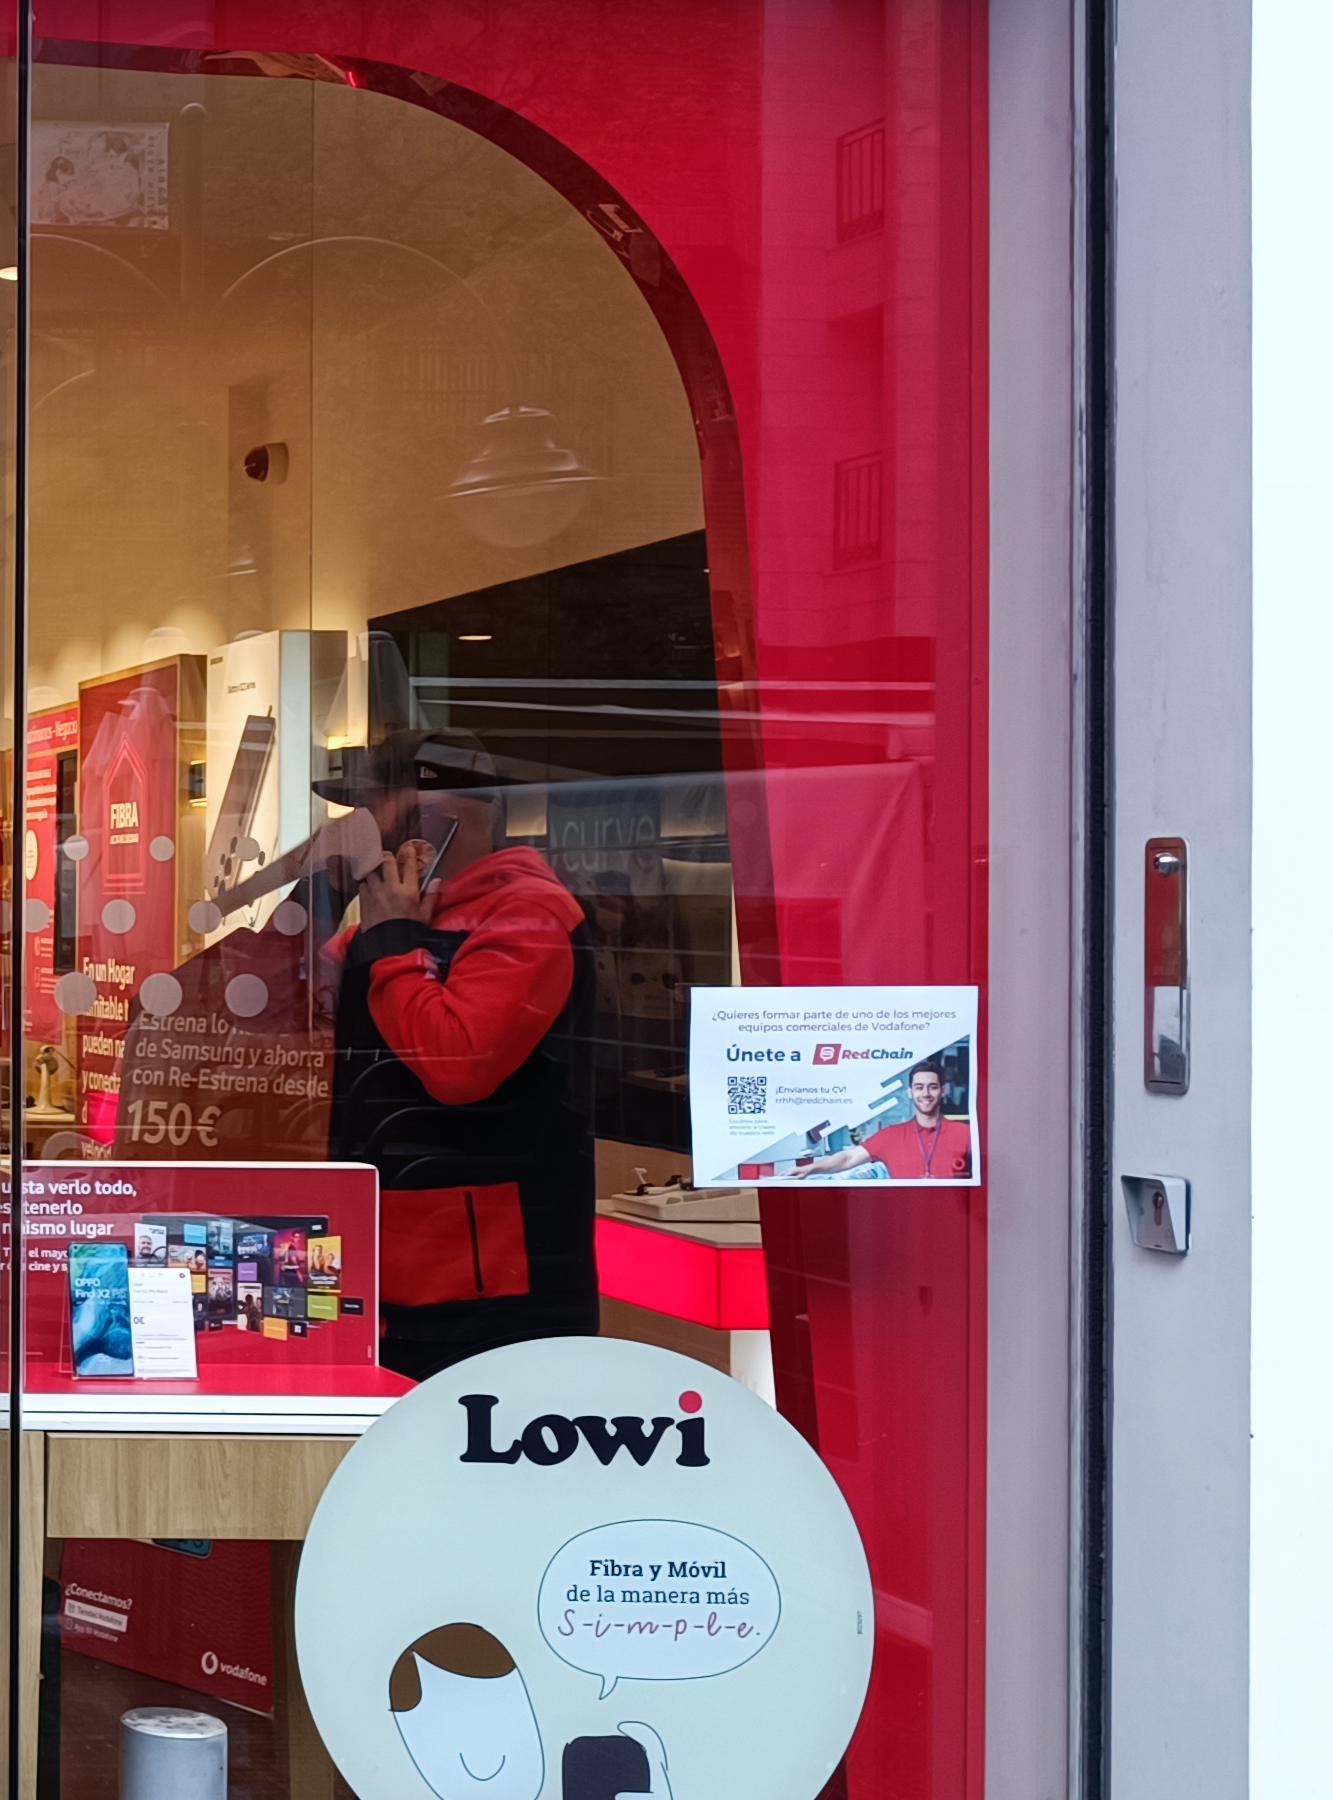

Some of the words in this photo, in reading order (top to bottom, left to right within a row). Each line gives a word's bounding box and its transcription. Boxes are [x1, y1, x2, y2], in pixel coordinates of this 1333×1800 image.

[110, 801, 139, 829] FIBRA
[94, 964, 106, 983] un
[108, 958, 135, 990] Hogar
[139, 1010, 207, 1033] Estrena
[211, 1013, 229, 1034] lo
[712, 1010, 759, 1022] ¿Quieres
[763, 1010, 800, 1020] formar
[803, 1010, 833, 1021] parte
[835, 1010, 849, 1019] de
[874, 1010, 890, 1019] de
[893, 1010, 909, 1019] los
[912, 1010, 956, 1021] mejores
[738, 1022, 783, 1032] equipos
[786, 1022, 852, 1032] comerciales
[855, 1022, 869, 1031] de
[871, 1021, 931, 1031] Vodafone?
[82, 1034, 114, 1059] pueden
[136, 1038, 156, 1058] de
[160, 1039, 245, 1069] Samsung
[248, 1049, 261, 1069] y
[264, 1045, 325, 1068] ahorra
[727, 1044, 785, 1062] Únete
[790, 1051, 801, 1062] a
[842, 1048, 913, 1060] RedChain
[133, 1069, 164, 1086] con
[169, 1066, 268, 1094] Re-Estrena
[273, 1075, 329, 1098] desde
[775, 1085, 818, 1094] ¡Envíanos
[821, 1086, 829, 1094] tu
[832, 1086, 846, 1094] CV!
[775, 1096, 853, 1106] rrhh@redchain.es
[48, 1180, 91, 1194] verlo
[95, 1180, 137, 1197] todo,
[71, 1220, 114, 1239] lugar
[29, 1248, 39, 1257] el
[29, 1262, 51, 1271] cine
[53, 1264, 60, 1273] y
[75, 1278, 101, 1287] OPPO
[75, 1289, 95, 1298] Find
[98, 1290, 110, 1298] X2
[458, 1390, 710, 1468] Lowi
[589, 1560, 643, 1578] Fibra
[649, 1563, 662, 1581] y
[667, 1560, 727, 1580] Móvil
[65, 1583, 133, 1610] ¿Conectamos?
[565, 1584, 591, 1603] de
[596, 1585, 616, 1604] la
[621, 1588, 700, 1606] manera
[705, 1587, 750, 1606] más
[220, 1662, 268, 1686] vodafone
